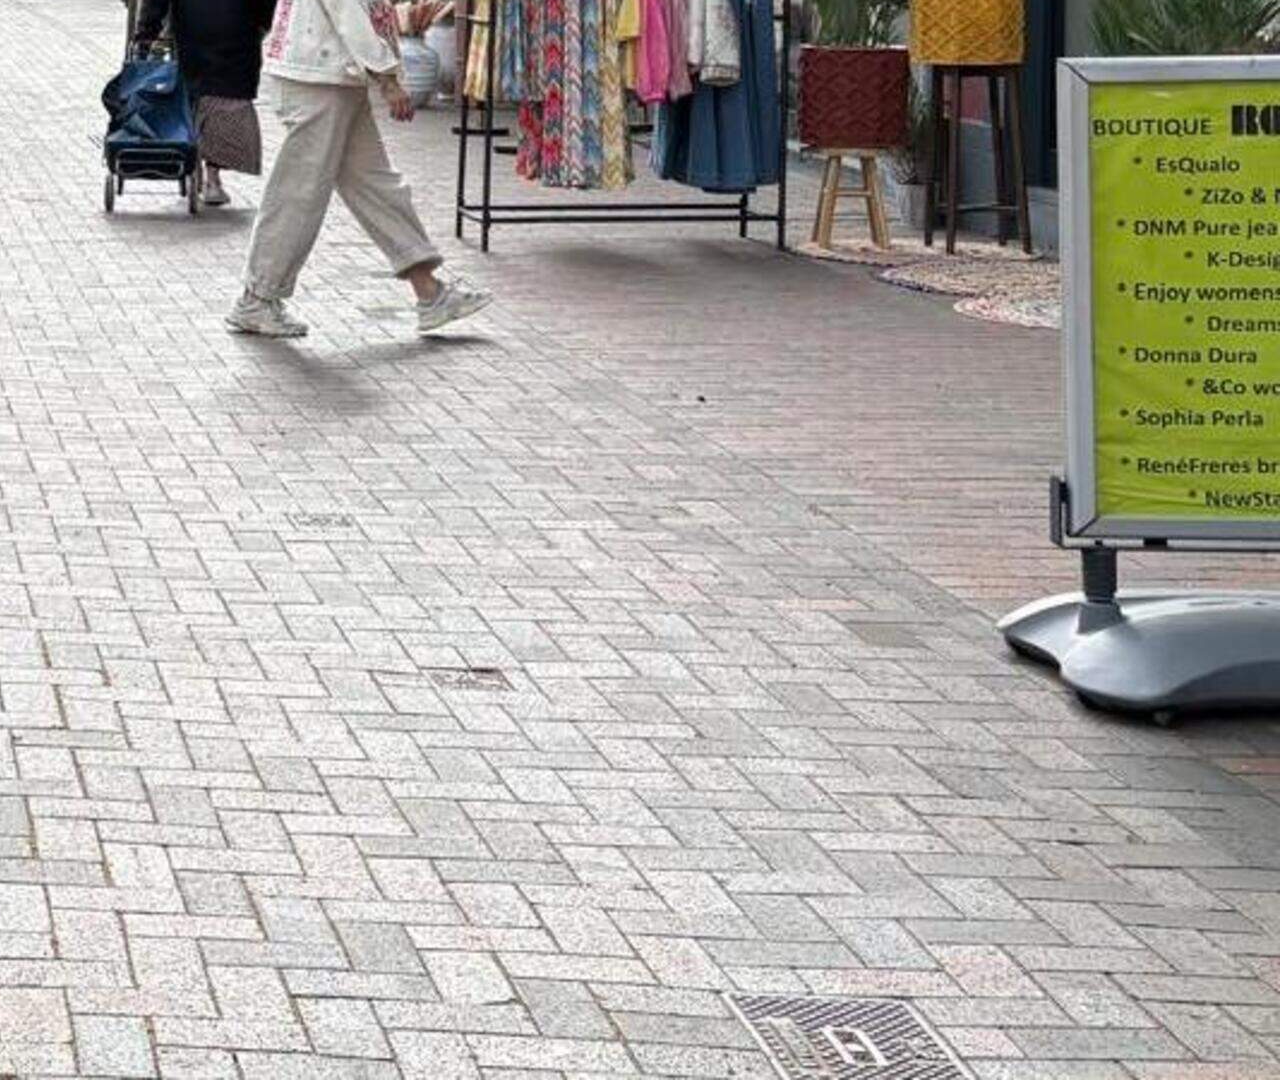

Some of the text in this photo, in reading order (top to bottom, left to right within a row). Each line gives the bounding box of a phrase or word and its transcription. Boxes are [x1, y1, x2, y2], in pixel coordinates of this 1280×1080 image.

[1093, 119, 1213, 137] BOUTIQUE
[1156, 156, 1240, 174] EsQualo
[1201, 188, 1244, 204] ZiZo
[1251, 188, 1266, 204] &
[1133, 220, 1187, 236] DNM
[1194, 220, 1240, 236] Pure
[1134, 283, 1190, 303] Enjoy
[1134, 347, 1257, 363] Donna Dura
[1203, 379, 1247, 395] &Co
[1136, 409, 1264, 428] Sophia Perla
